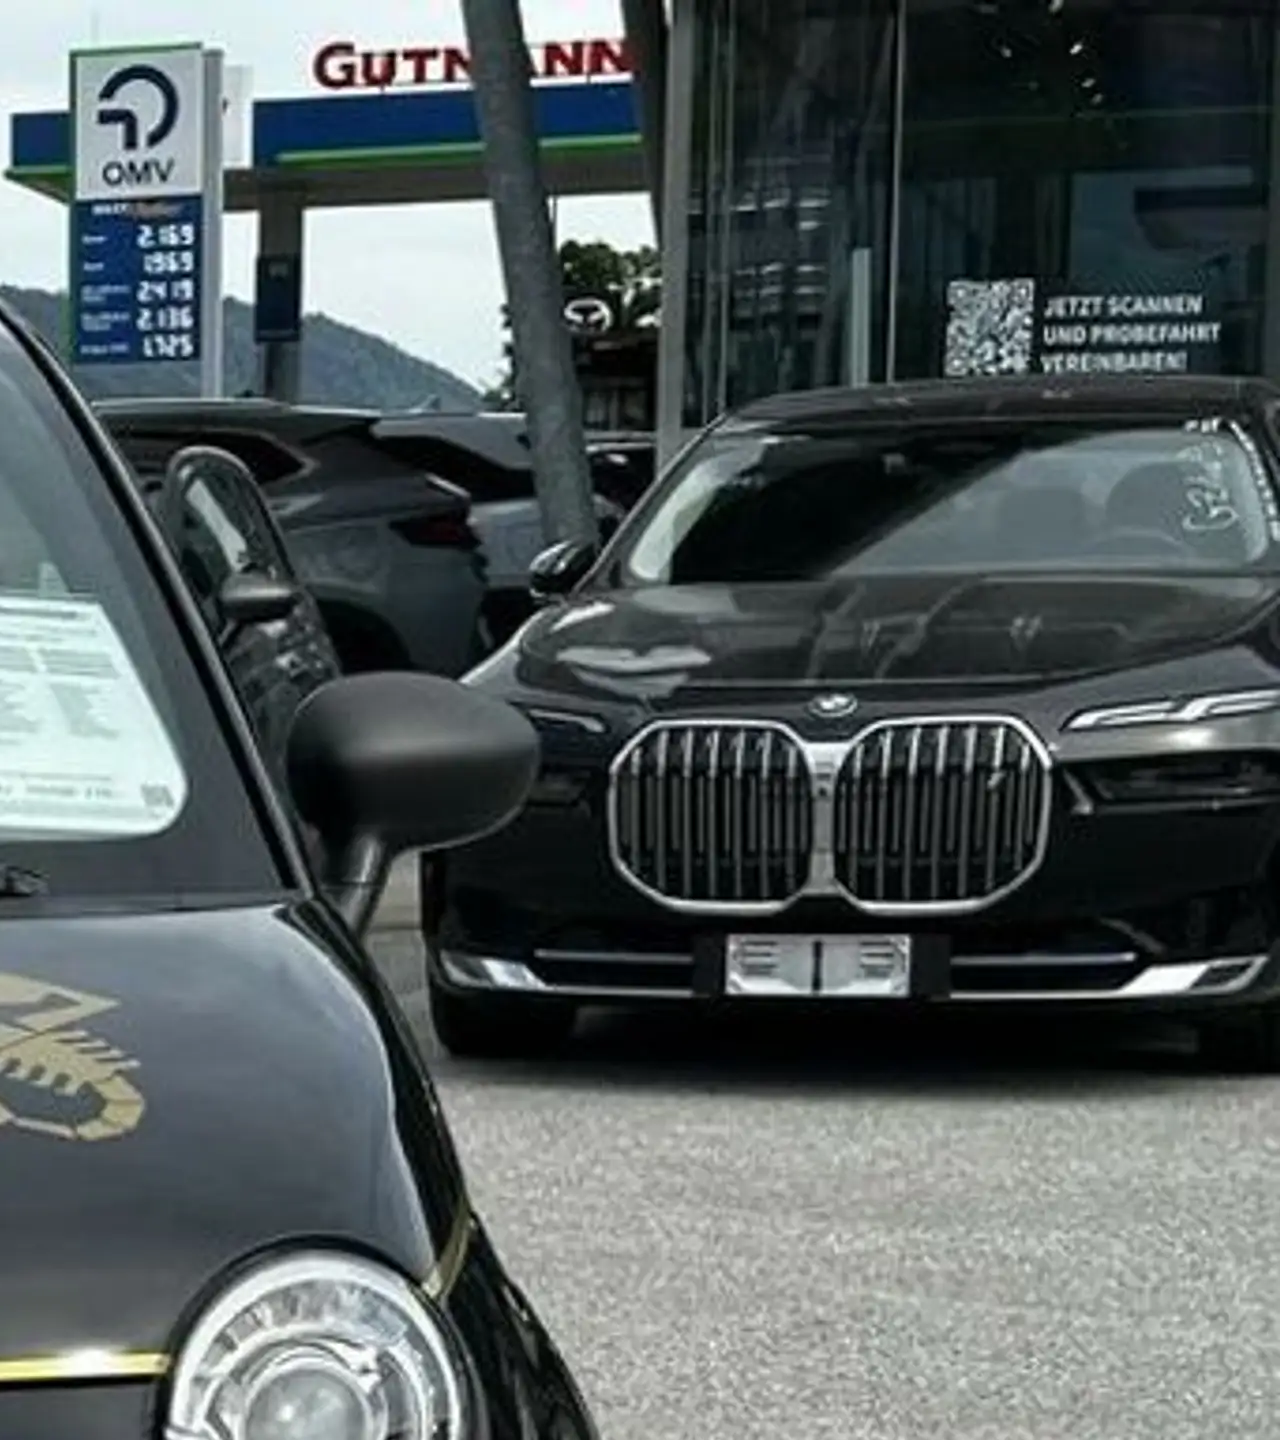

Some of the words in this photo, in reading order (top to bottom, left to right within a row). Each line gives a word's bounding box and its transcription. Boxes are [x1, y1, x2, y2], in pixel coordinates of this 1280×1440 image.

[101, 157, 175, 188] OMV
[1043, 295, 1104, 319] JETZT
[1107, 293, 1203, 316] SCANNEN
[1042, 323, 1087, 347] UND
[1090, 320, 1222, 346] PROBEFAHRT
